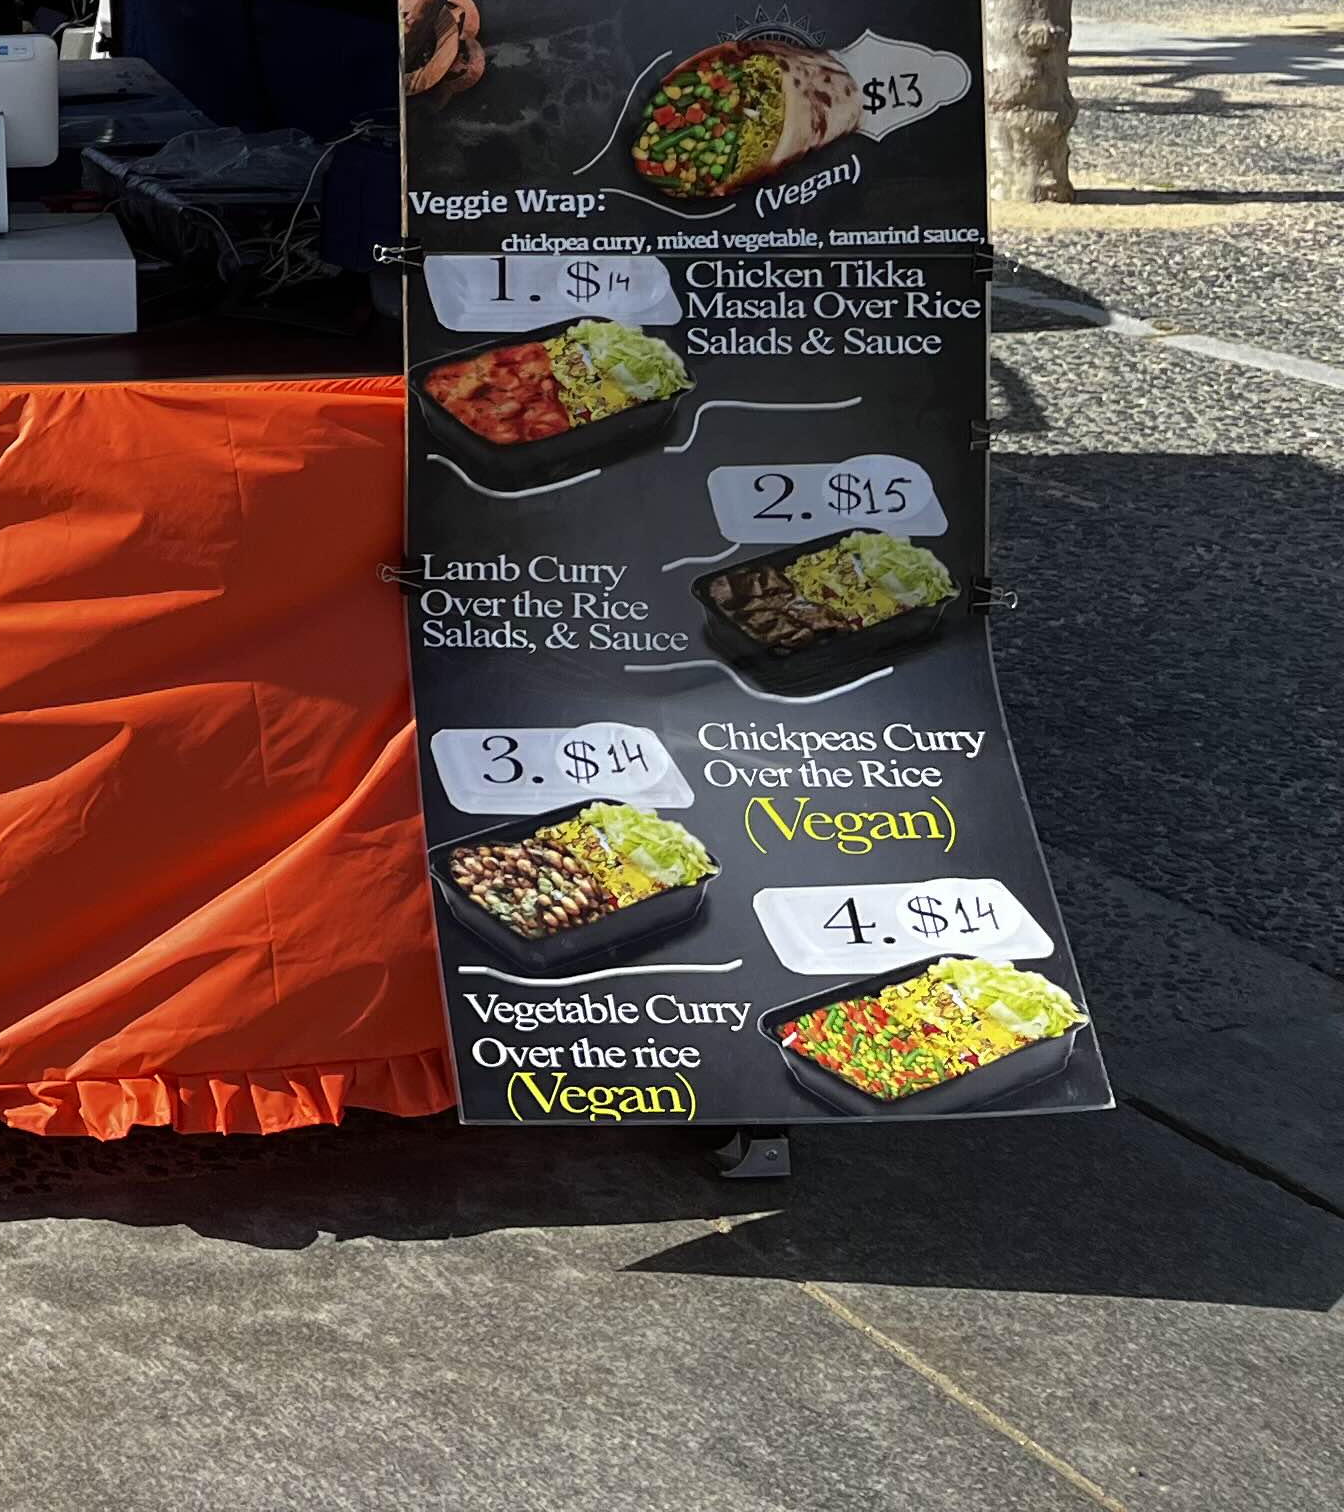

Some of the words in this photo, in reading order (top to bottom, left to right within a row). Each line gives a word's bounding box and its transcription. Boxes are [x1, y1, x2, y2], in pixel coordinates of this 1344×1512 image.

[755, 154, 861, 218] (Vegan)
[408, 190, 508, 221] Veggie
[515, 188, 606, 218] Wrap:
[501, 234, 593, 255] chickpea
[596, 234, 653, 254] curry,
[657, 231, 719, 250] mixed
[722, 228, 822, 251] vegetable,
[828, 226, 919, 245] tamarind
[923, 226, 986, 245] sauce,
[489, 257, 542, 302] 1.
[686, 262, 824, 289] Chicken
[830, 260, 926, 288] Tikka
[687, 293, 805, 321] Masala
[813, 294, 905, 320] Over
[909, 292, 981, 319] Rice
[687, 329, 793, 355] Salads
[800, 330, 835, 355] &
[842, 330, 942, 355] Sauce
[752, 472, 813, 522] 2.
[827, 472, 913, 515] $15
[421, 555, 520, 583] Lamb
[529, 556, 627, 590] Curry
[420, 591, 509, 619] Over
[511, 590, 565, 618] the
[571, 593, 649, 621] Rice
[422, 621, 537, 653] Salads,
[544, 623, 580, 649] &
[588, 625, 688, 652] Sauce
[697, 722, 877, 759] Chickpeas
[884, 725, 985, 759] Curry
[481, 735, 545, 786] 3.
[563, 738, 649, 785] $14
[703, 760, 793, 789] Over
[797, 761, 853, 788] the
[860, 761, 942, 788] Rice
[744, 795, 957, 856] (Vegan)
[823, 896, 897, 946] 4.
[908, 895, 1000, 937] $14
[463, 994, 639, 1031] Vegetable
[645, 994, 752, 1031] Curry
[471, 1038, 564, 1068] Over
[569, 1038, 627, 1068] the
[631, 1038, 701, 1068] rice
[507, 1072, 696, 1121] (Vegan)
